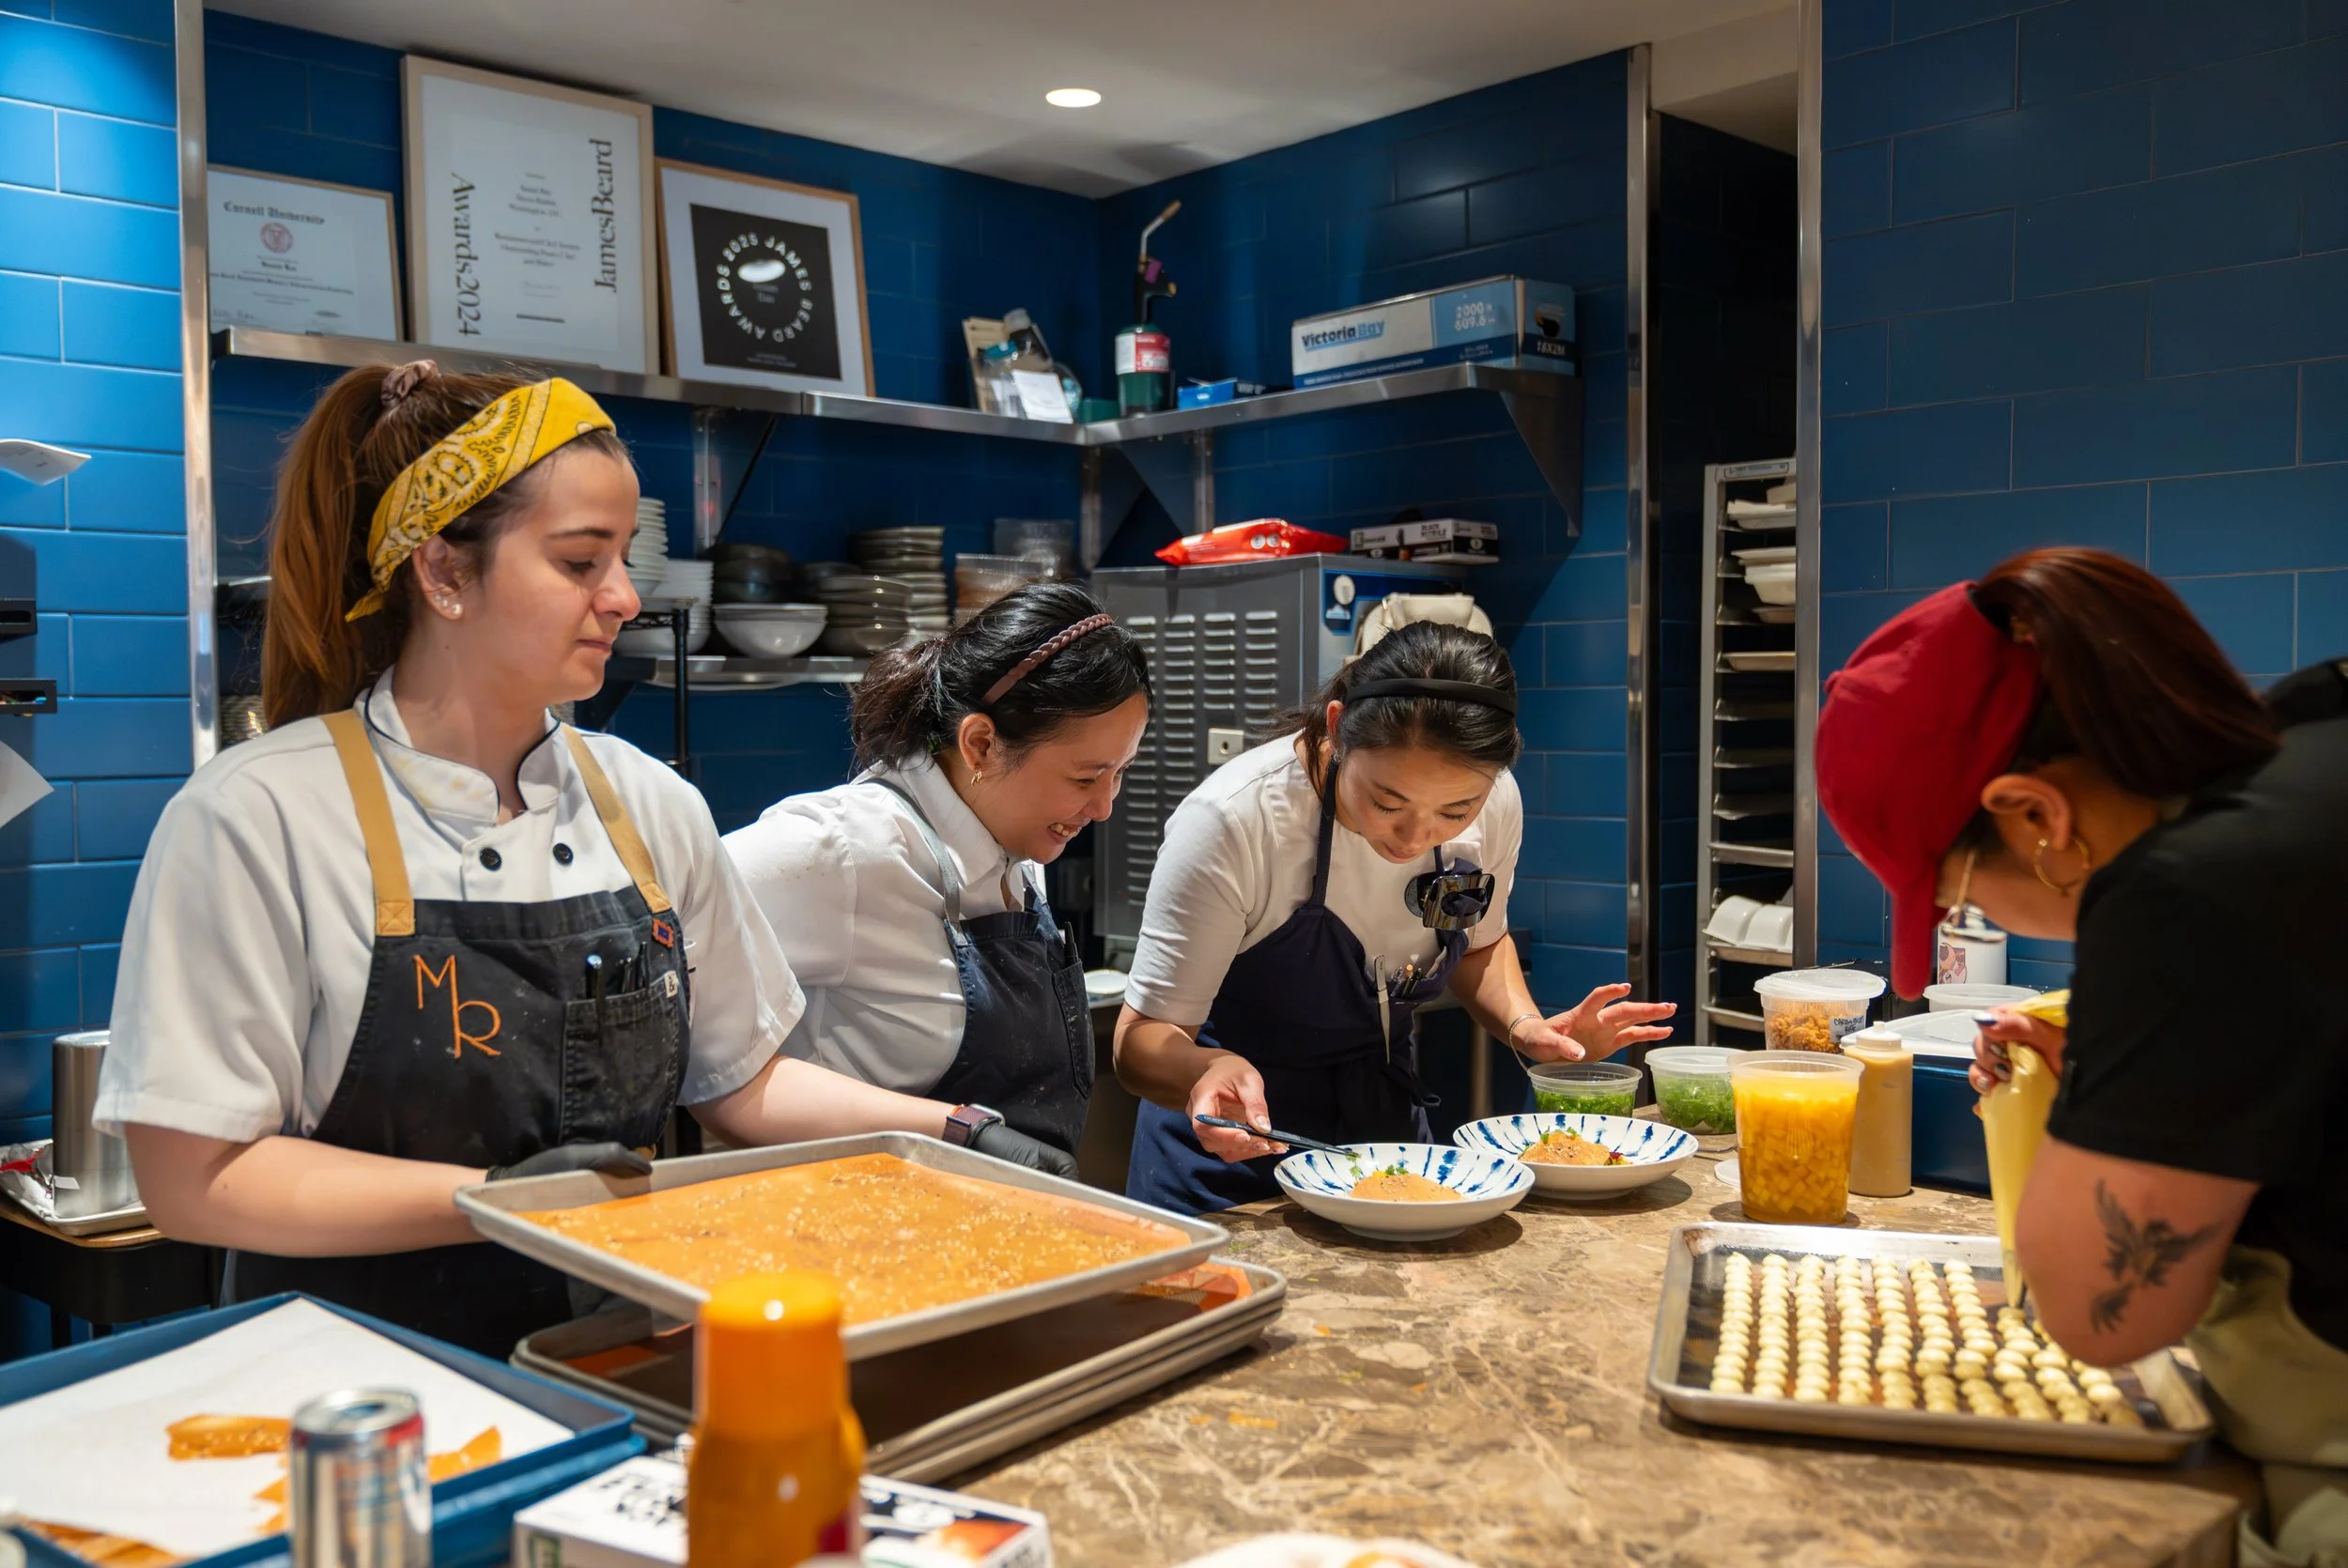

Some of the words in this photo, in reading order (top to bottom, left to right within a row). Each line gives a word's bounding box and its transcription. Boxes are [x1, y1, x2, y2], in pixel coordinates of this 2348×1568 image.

[223, 200, 265, 216] Cornell
[722, 231, 759, 262] 2025
[764, 235, 812, 291] JAMES
[716, 264, 765, 340] AWARDS
[771, 298, 813, 343] BEARD
